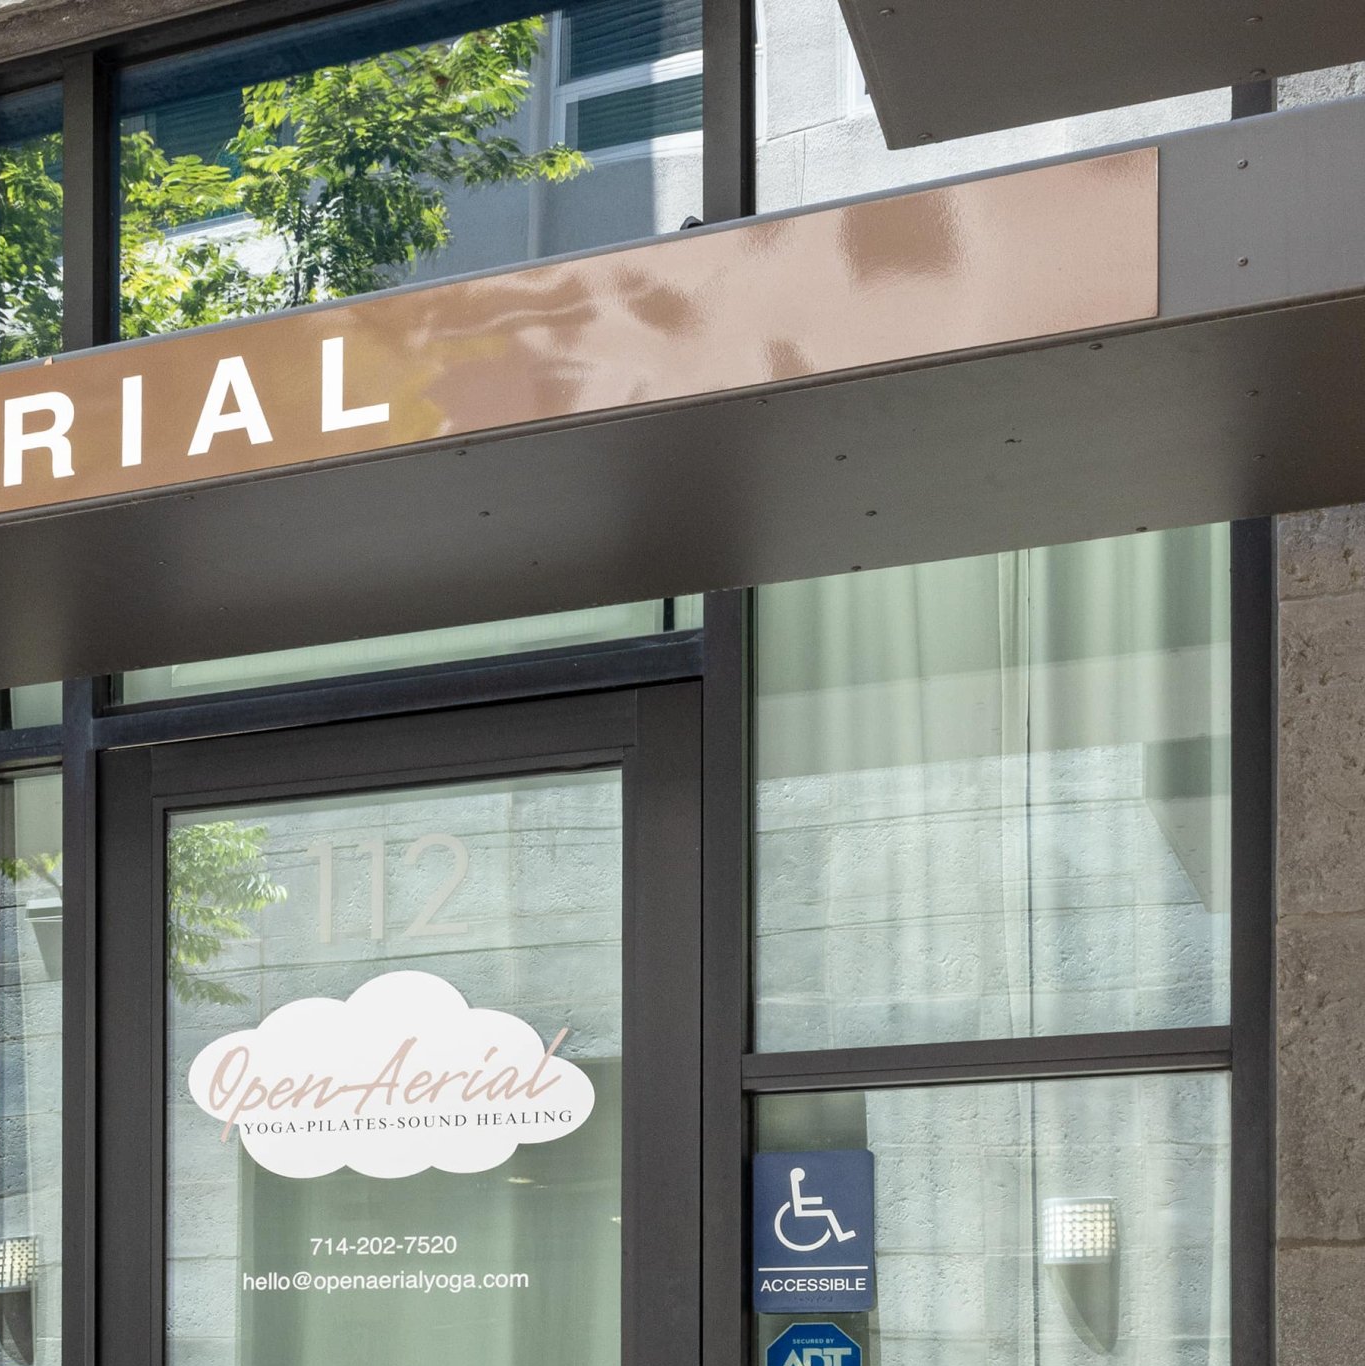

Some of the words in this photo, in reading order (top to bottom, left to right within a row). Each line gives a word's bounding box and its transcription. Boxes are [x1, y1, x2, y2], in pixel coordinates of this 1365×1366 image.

[306, 833, 470, 944] 112
[209, 1045, 342, 1143] Open
[337, 1027, 569, 1115] Aerial
[243, 1113, 468, 1135] YOGA-PILATES-SOUND
[476, 1109, 573, 1127] HEALING
[310, 1235, 458, 1256] 714-202-7520
[242, 1269, 530, 1294] hello@openaerialyoga.com
[760, 1277, 867, 1293] ACCESSIBLE
